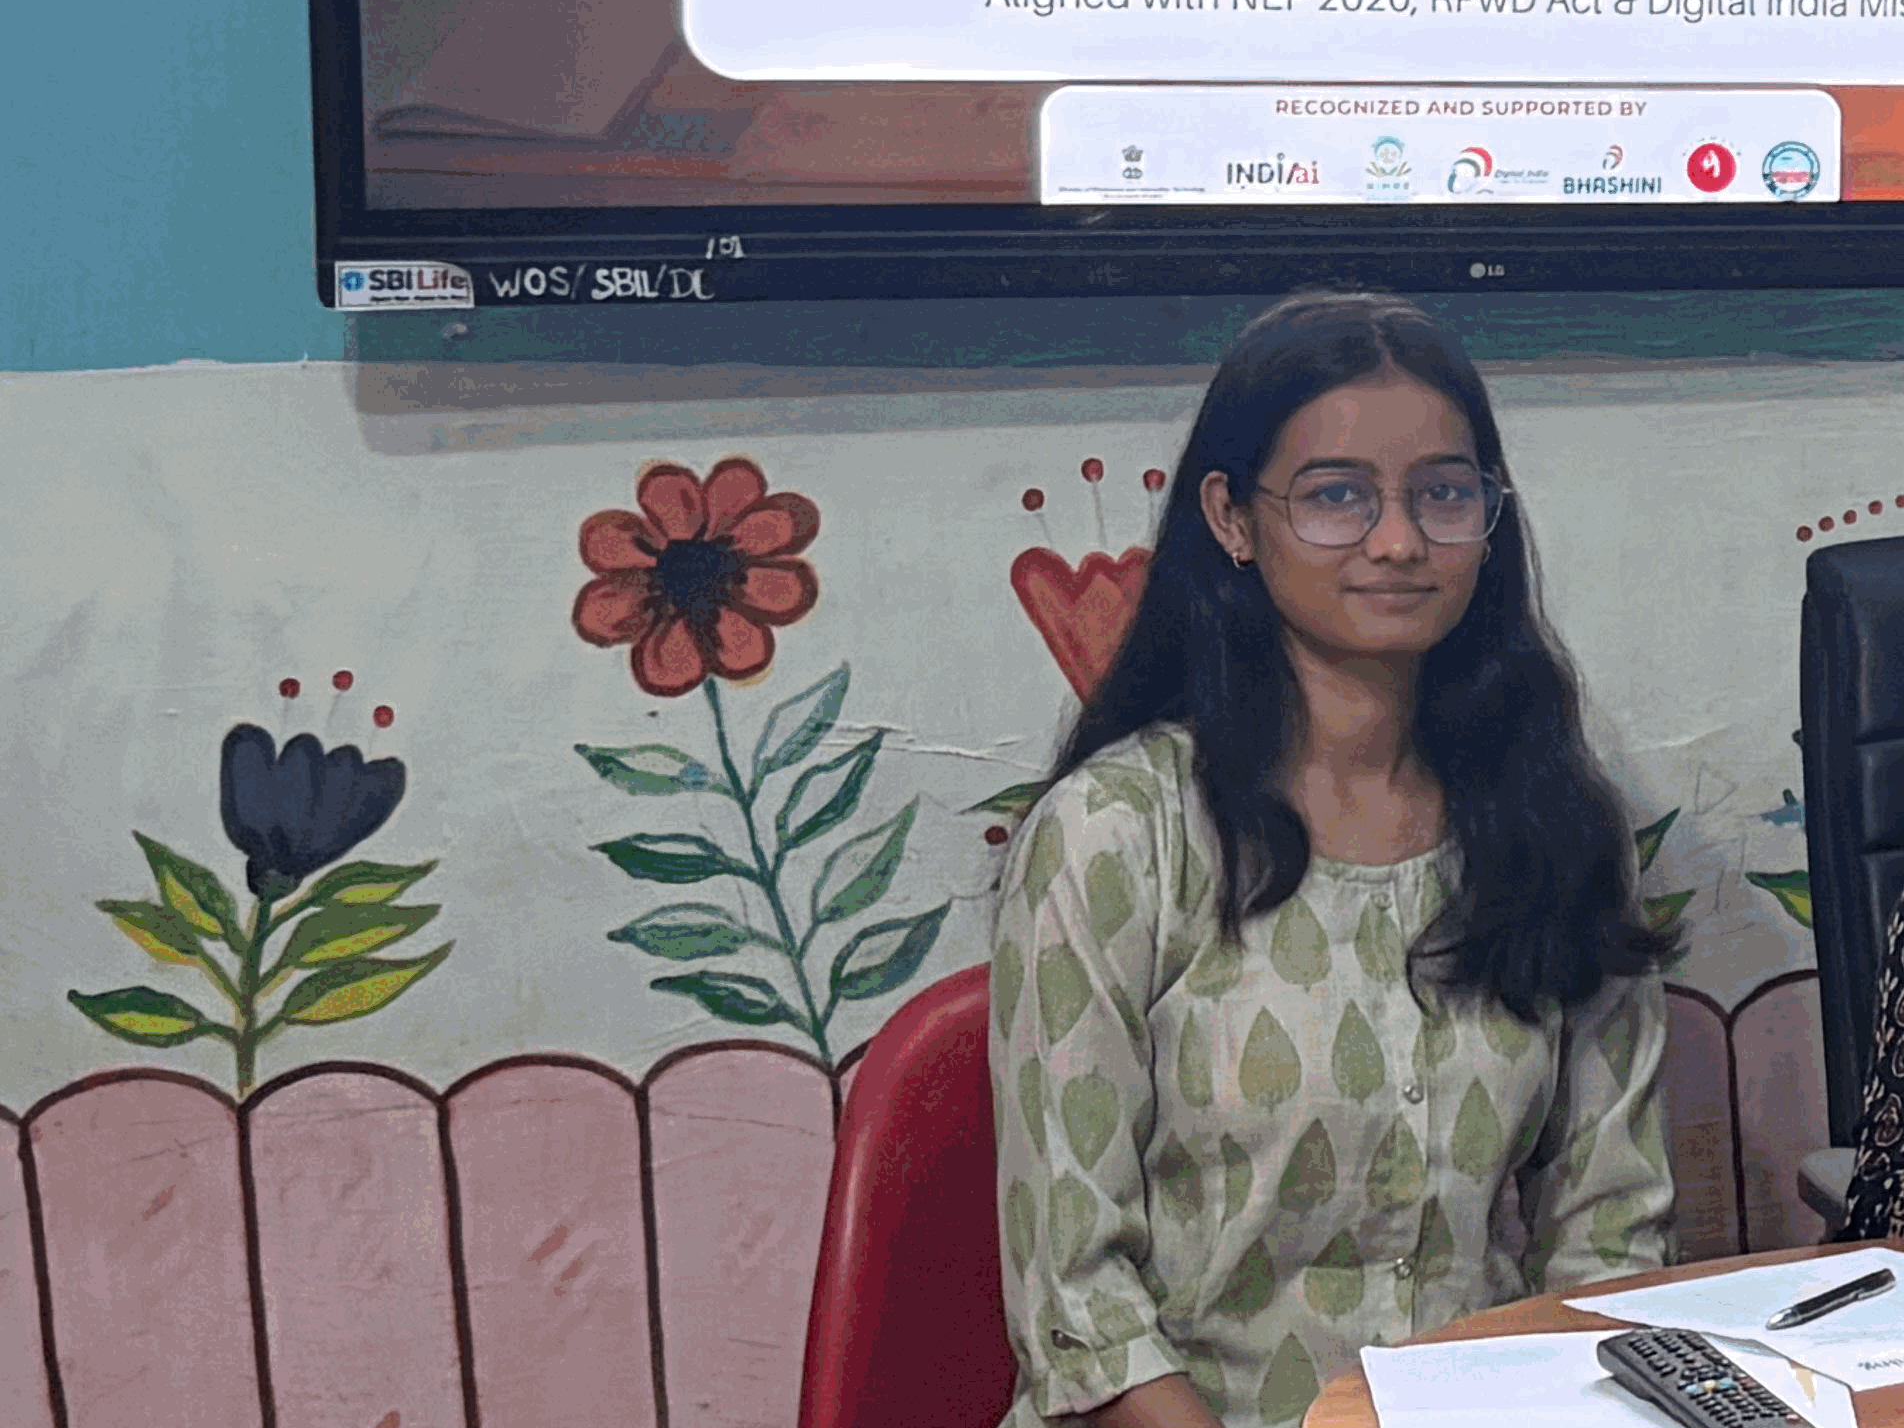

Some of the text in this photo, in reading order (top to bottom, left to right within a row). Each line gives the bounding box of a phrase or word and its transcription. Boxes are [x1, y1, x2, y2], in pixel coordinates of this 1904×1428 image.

[1275, 99, 1648, 117] RECOGNIZED AND SUPPORTED BY
[1562, 176, 1662, 195] BHASHINI
[369, 269, 467, 290] SBI Life
